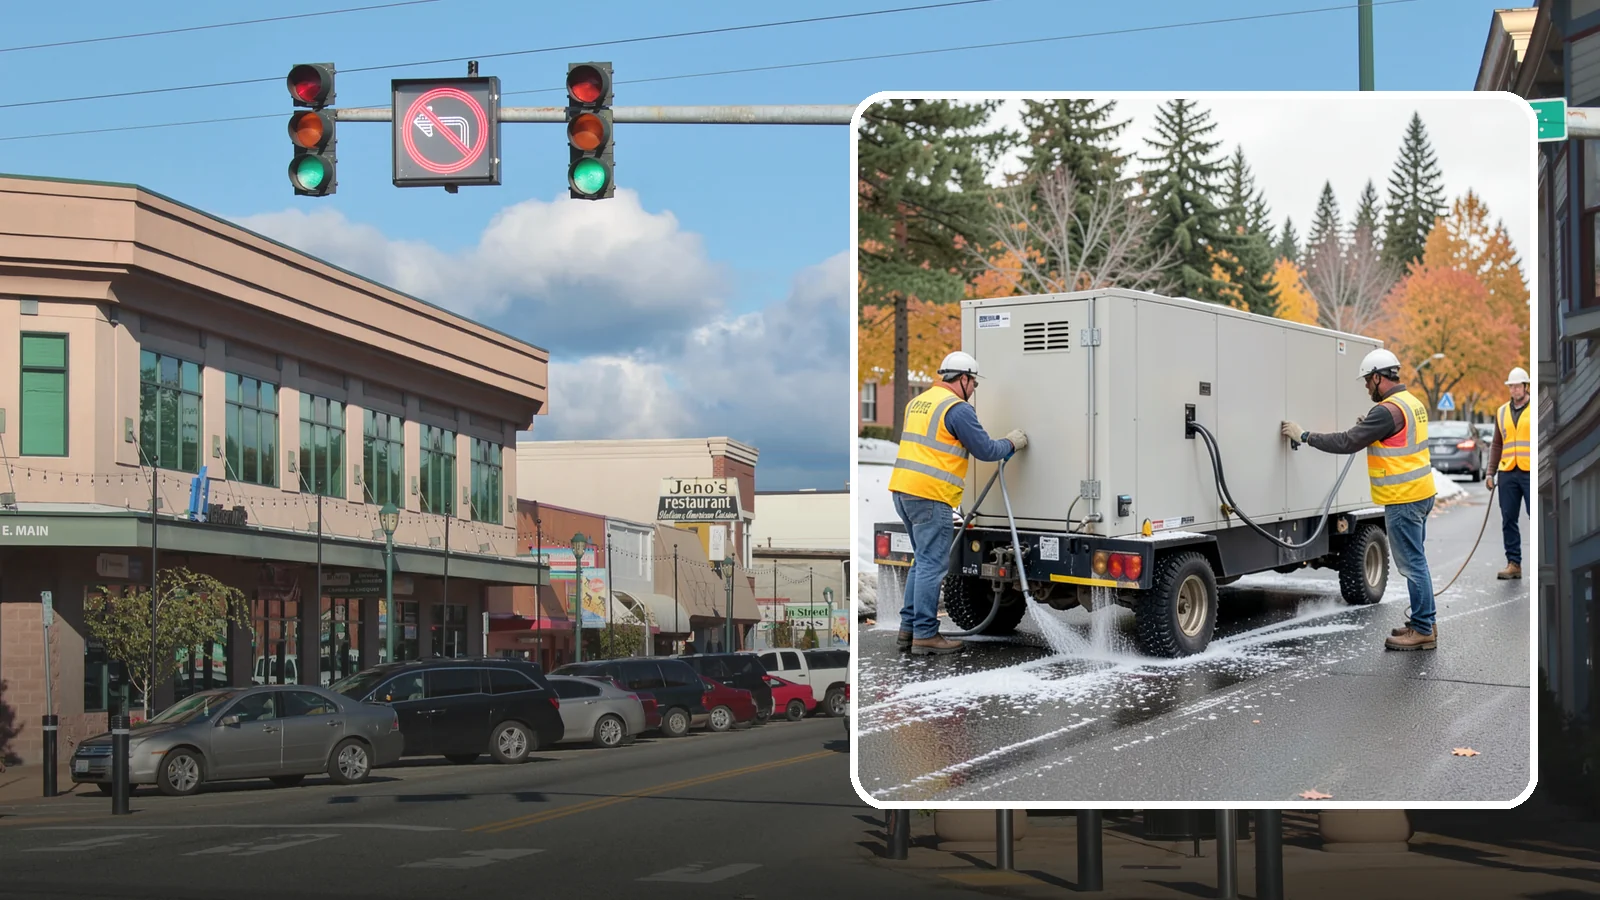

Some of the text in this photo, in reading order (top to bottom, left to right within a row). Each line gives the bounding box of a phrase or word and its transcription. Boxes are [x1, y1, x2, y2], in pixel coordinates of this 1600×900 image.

[669, 480, 728, 494] Jeno's
[665, 497, 731, 508] restaurant
[659, 510, 681, 519] Italian
[686, 510, 714, 519] American
[715, 510, 737, 519] Cuisine
[2, 525, 49, 536] E. MAIN
[797, 607, 828, 616] Street
